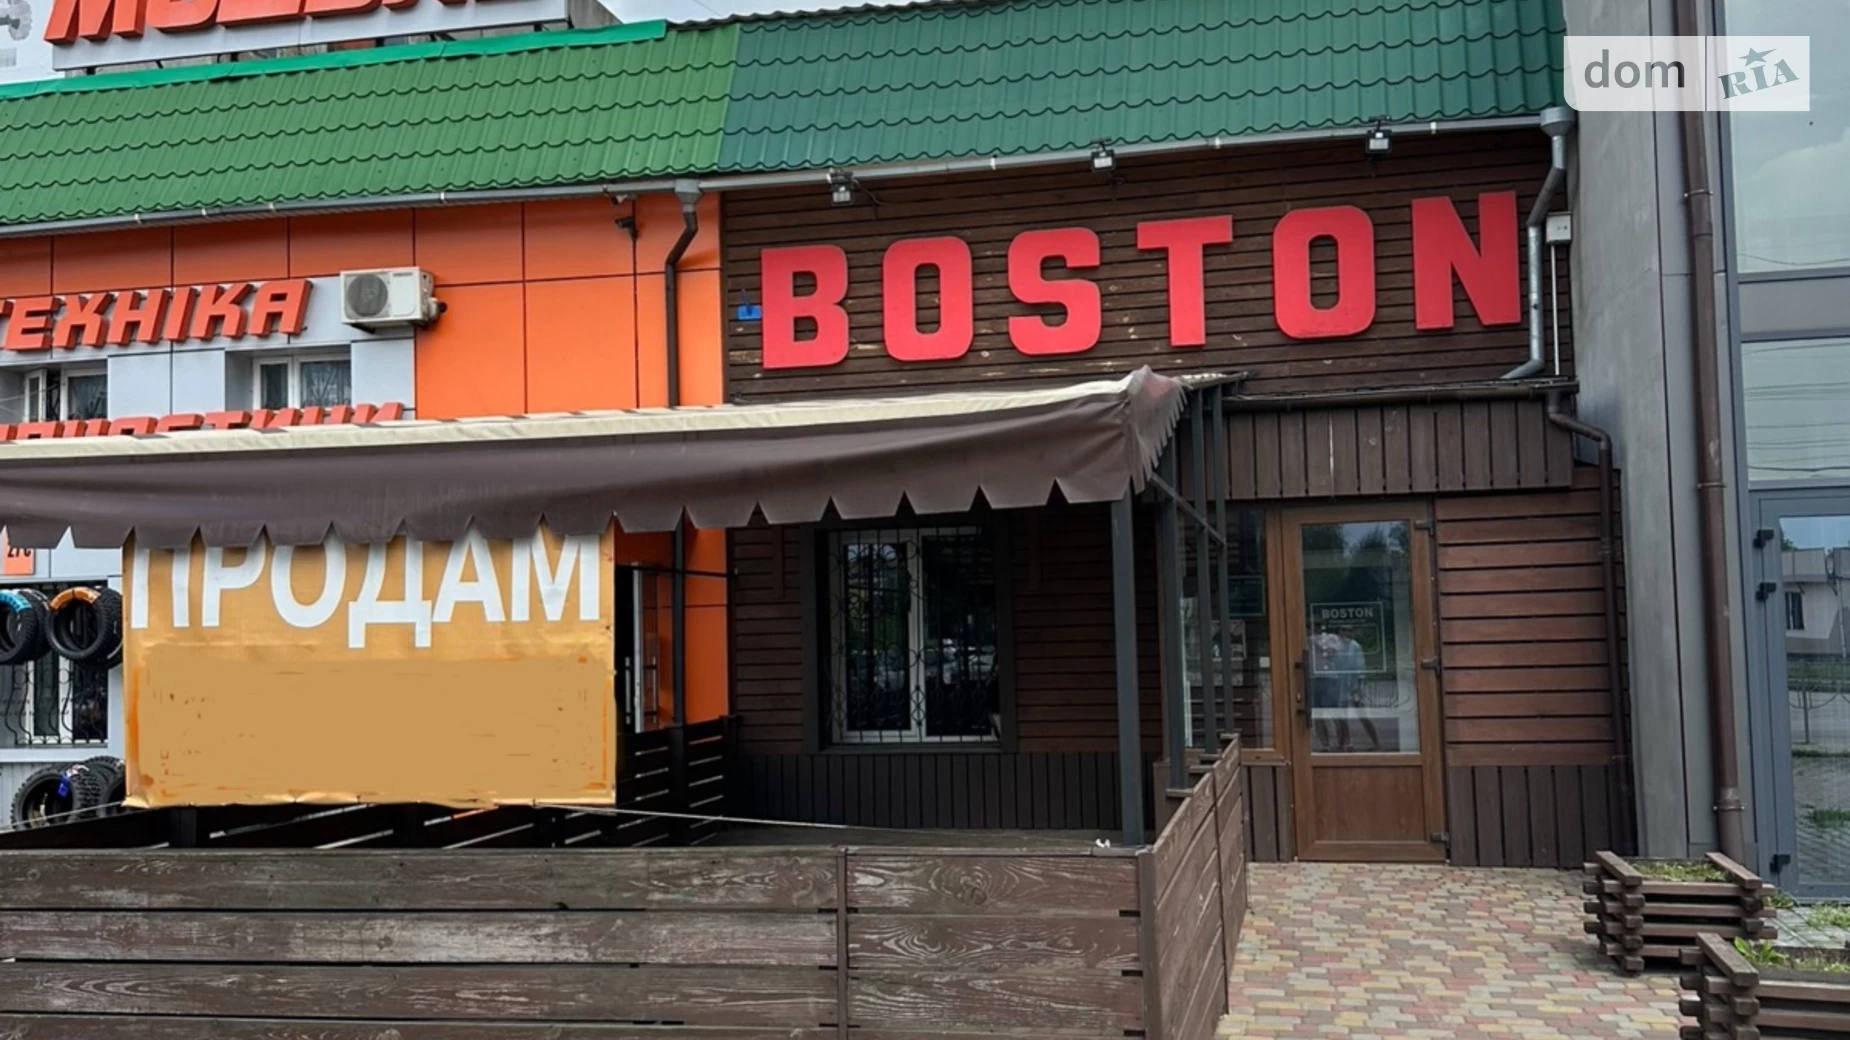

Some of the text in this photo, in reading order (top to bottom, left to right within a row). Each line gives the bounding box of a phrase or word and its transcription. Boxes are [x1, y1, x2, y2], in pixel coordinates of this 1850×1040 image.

[0, 279, 312, 351] ЕХНІКА
[761, 190, 1522, 369] BOSTON
[131, 526, 600, 649] ПРОДАМ
[1321, 607, 1374, 619] BOSTON
